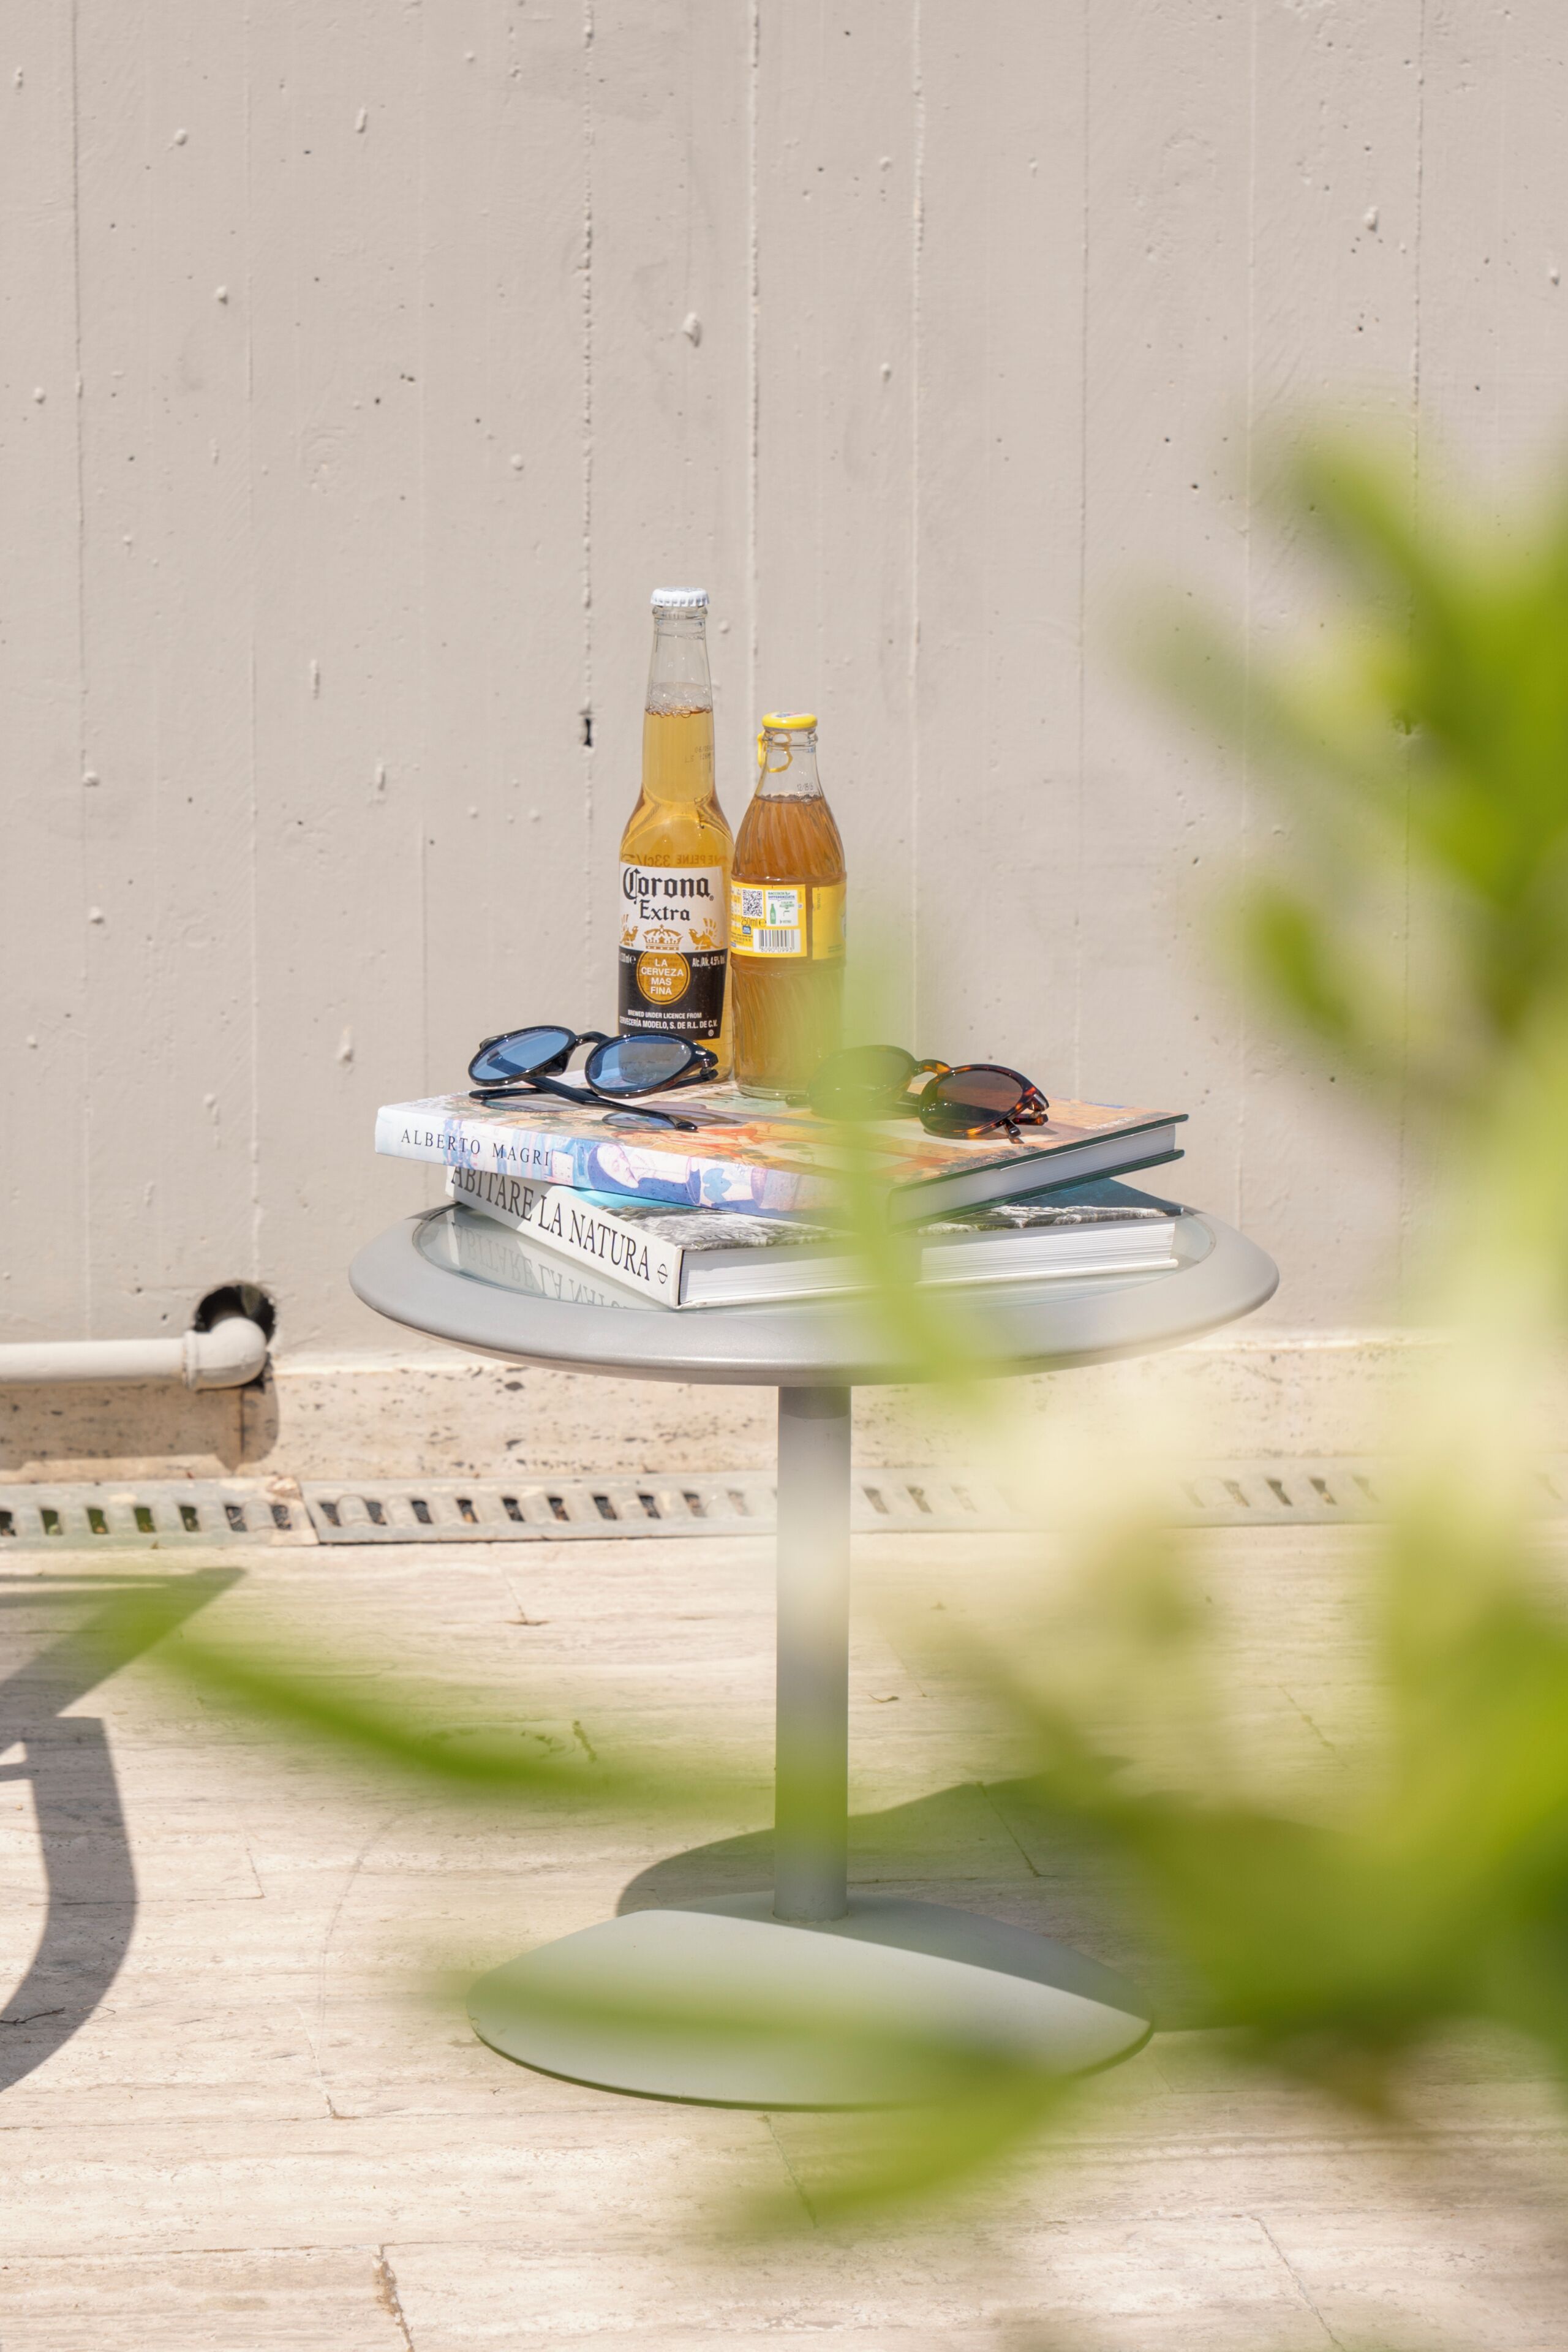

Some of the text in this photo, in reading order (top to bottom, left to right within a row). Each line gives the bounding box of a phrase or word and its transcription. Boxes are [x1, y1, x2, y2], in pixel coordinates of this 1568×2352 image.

[623, 867, 710, 904] Corona
[639, 899, 690, 921] Extra
[641, 967, 684, 976] CERVEZA
[650, 977, 672, 986] MAS
[650, 987, 673, 995] FINA
[643, 1020, 668, 1030] MODELO,
[708, 1019, 718, 1028] C.V.
[401, 1129, 549, 1166] ALBERTO MAGRI
[451, 1166, 650, 1281] ABITARE LA NATURA
